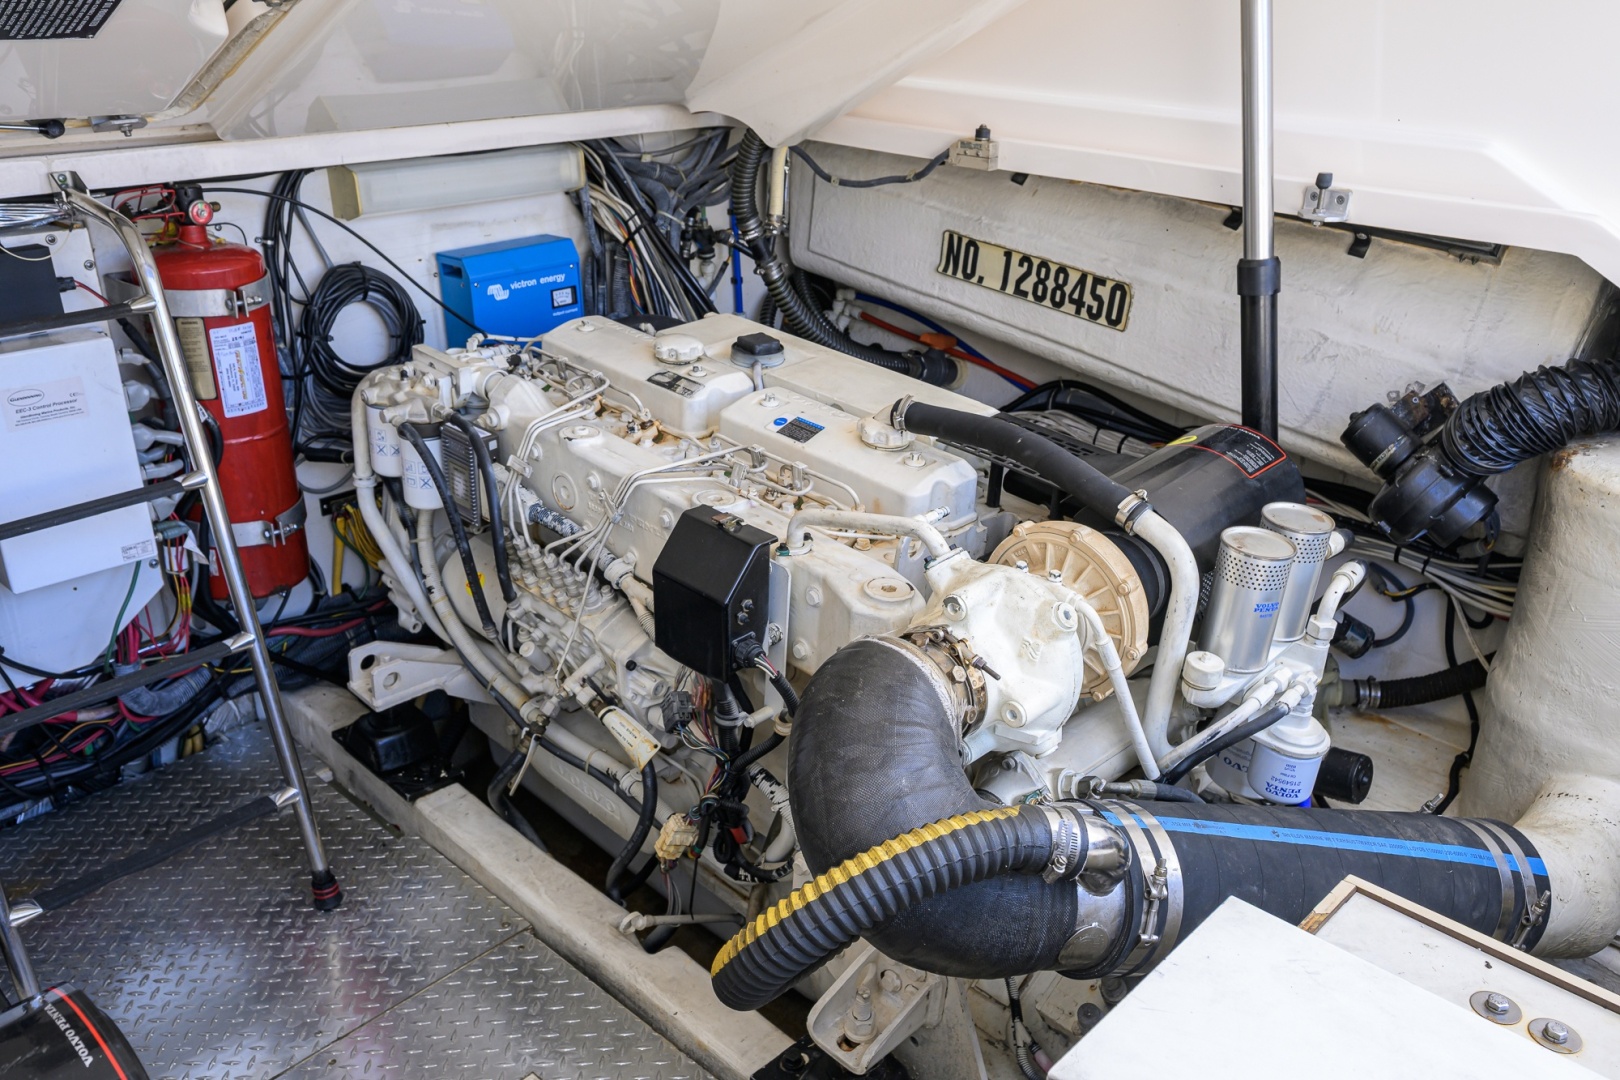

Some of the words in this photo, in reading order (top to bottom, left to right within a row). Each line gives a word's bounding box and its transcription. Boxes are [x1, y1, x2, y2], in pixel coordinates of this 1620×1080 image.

[509, 278, 537, 290] victron
[539, 273, 566, 284] energy
[942, 233, 985, 285] NO.
[1000, 250, 1127, 328] 1288450
[15, 406, 32, 414] EEC-3
[32, 403, 52, 411] Control
[52, 398, 78, 407] Processor
[1223, 756, 1248, 773] LVO
[1265, 781, 1302, 794] PENTA
[1270, 775, 1302, 787] 21549542
[1265, 787, 1300, 799] VOLVO
[44, 1003, 71, 1031] PENTA
[64, 1029, 94, 1068] VOLVO
